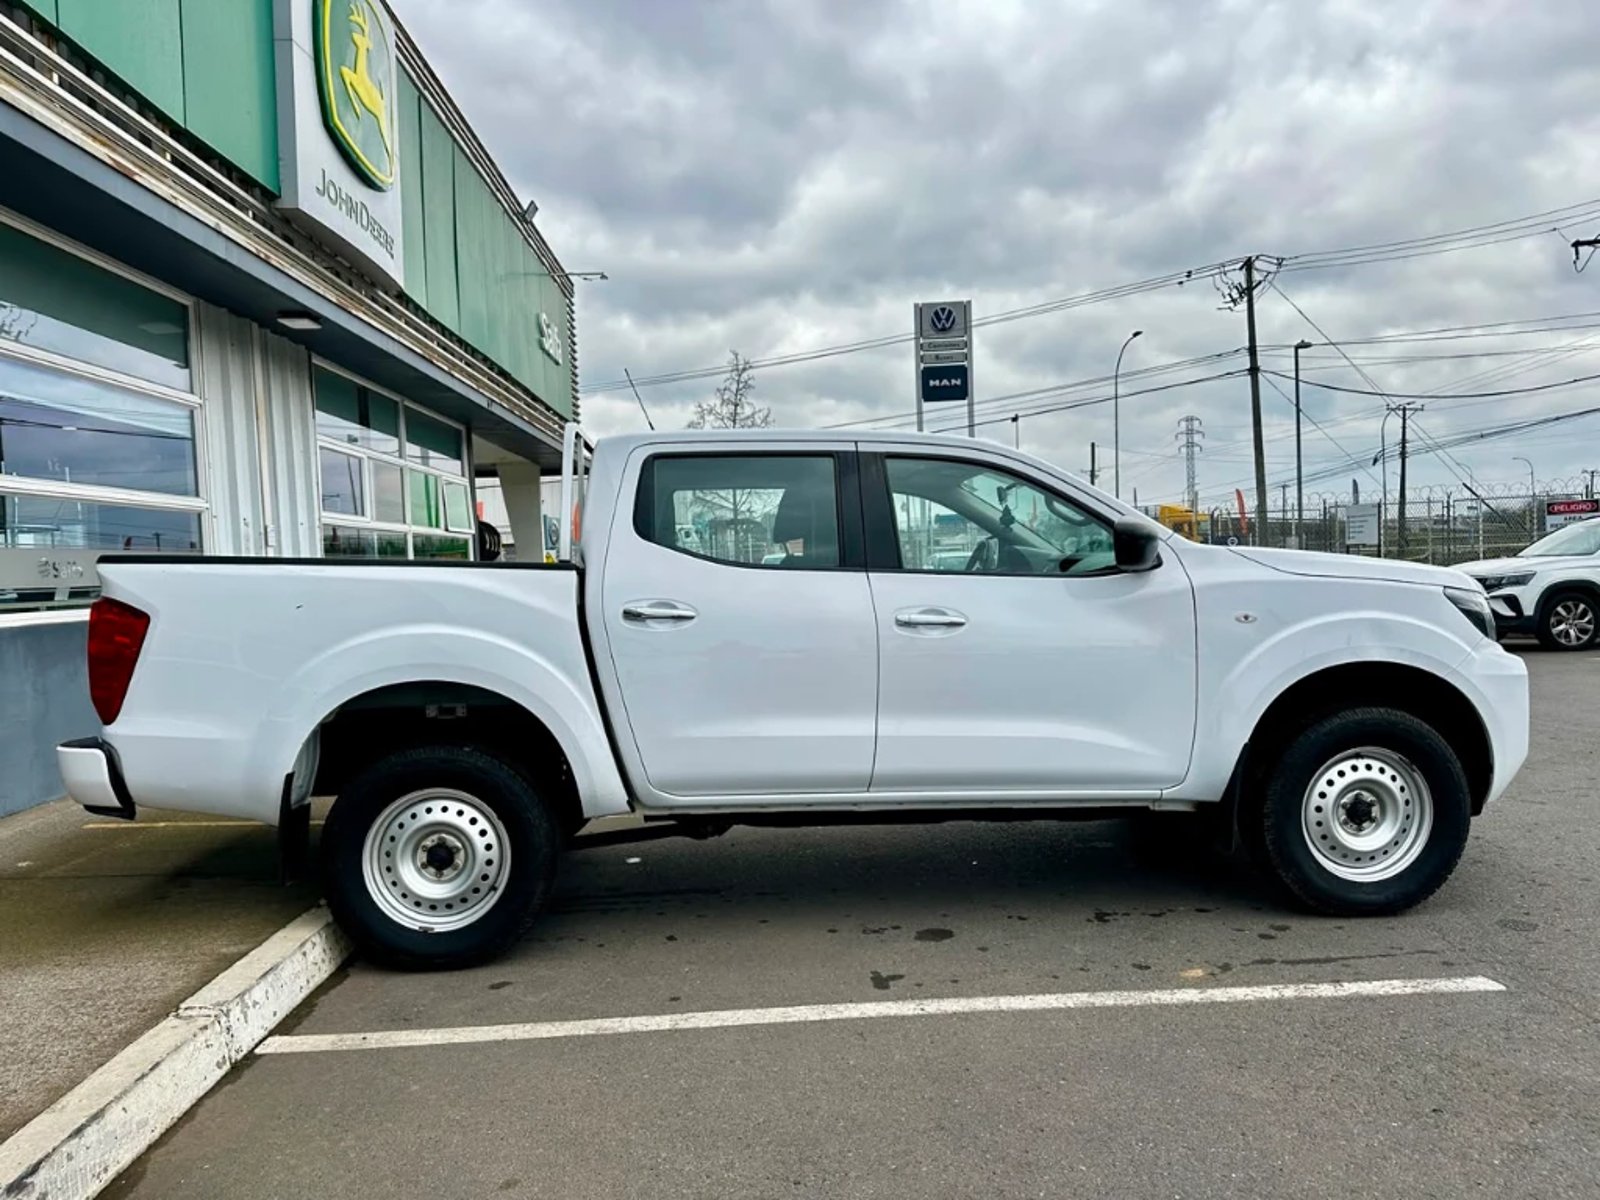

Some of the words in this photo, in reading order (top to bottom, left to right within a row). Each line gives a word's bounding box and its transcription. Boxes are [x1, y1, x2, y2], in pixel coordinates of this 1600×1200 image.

[315, 168, 359, 225] JOHN
[359, 200, 395, 260] DEERE
[929, 378, 962, 387] MAN
[1553, 502, 1592, 512] PELIGRO
